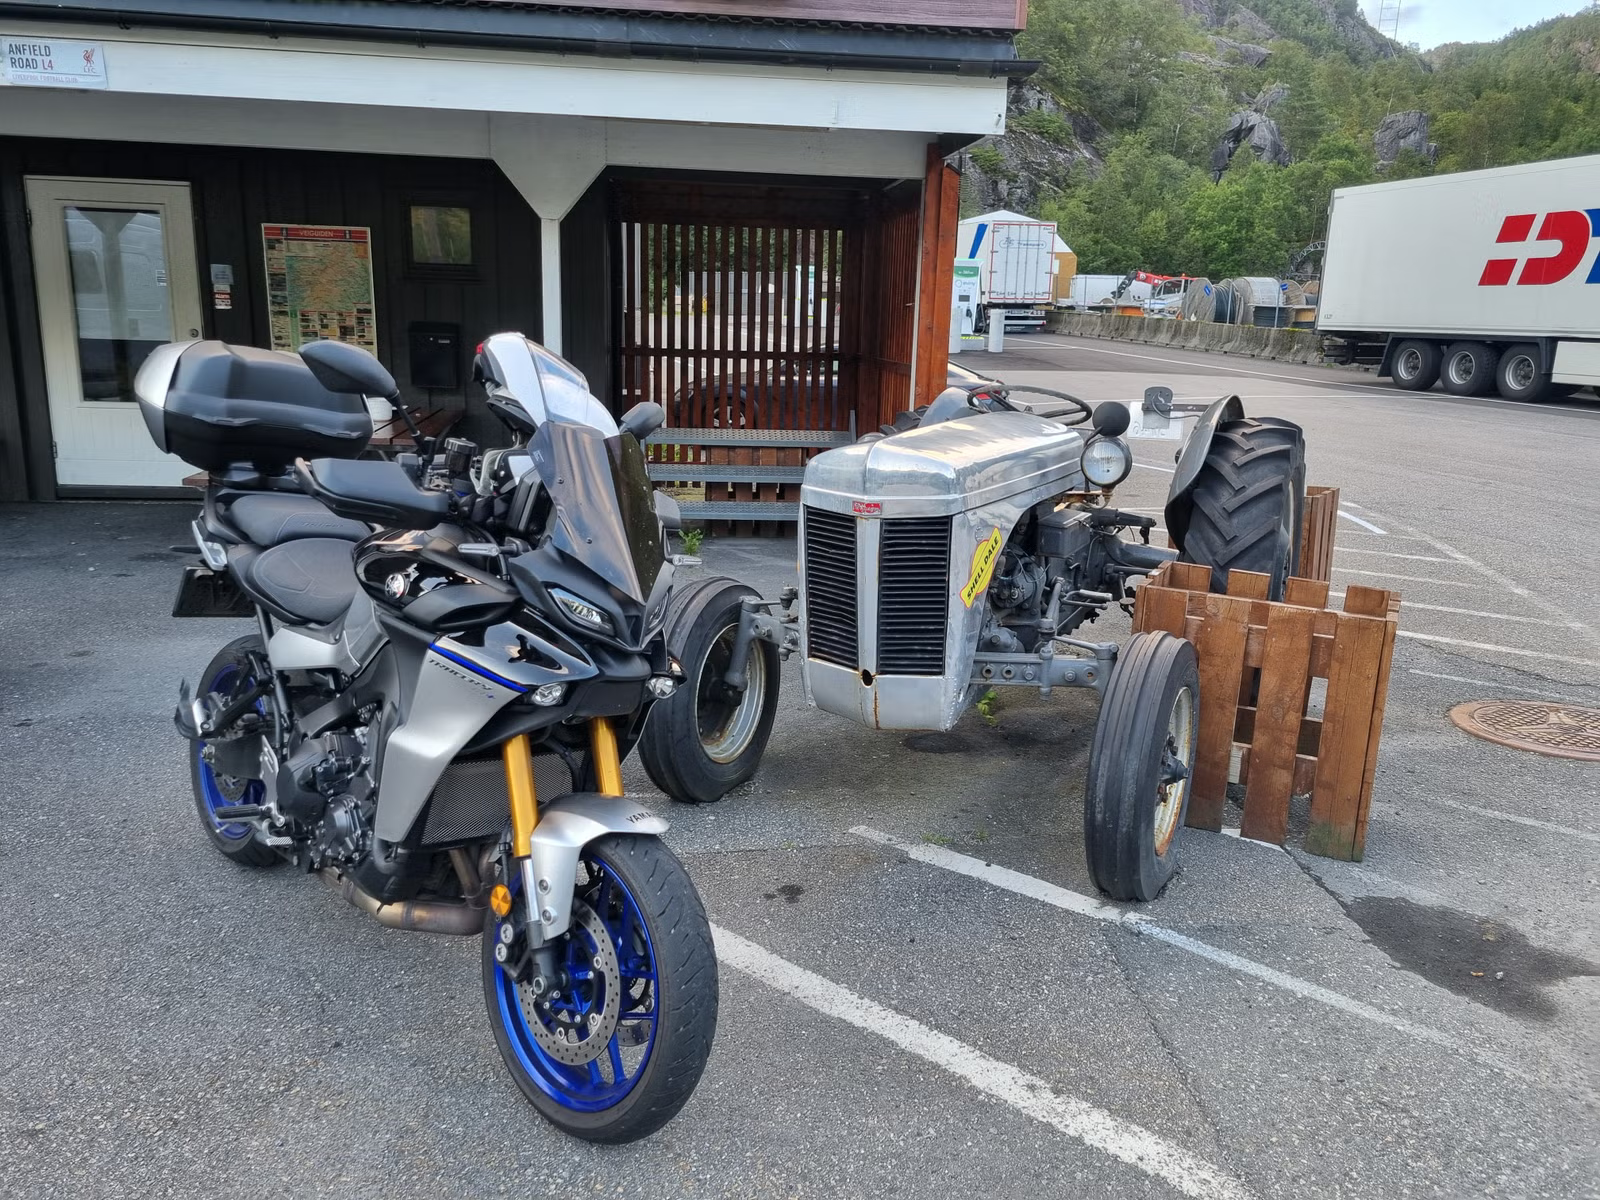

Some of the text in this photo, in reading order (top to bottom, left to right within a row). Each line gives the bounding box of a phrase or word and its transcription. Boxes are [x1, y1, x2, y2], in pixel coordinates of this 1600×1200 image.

[8, 43, 51, 57] ANFIELD
[10, 57, 54, 70] ROAD L4
[83, 66, 96, 74] LFC
[40, 75, 64, 83] FOOTBALL
[65, 76, 79, 84] CLUB
[300, 230, 335, 238] VEIGUIDEN
[966, 536, 1000, 600] SHELL DALE
